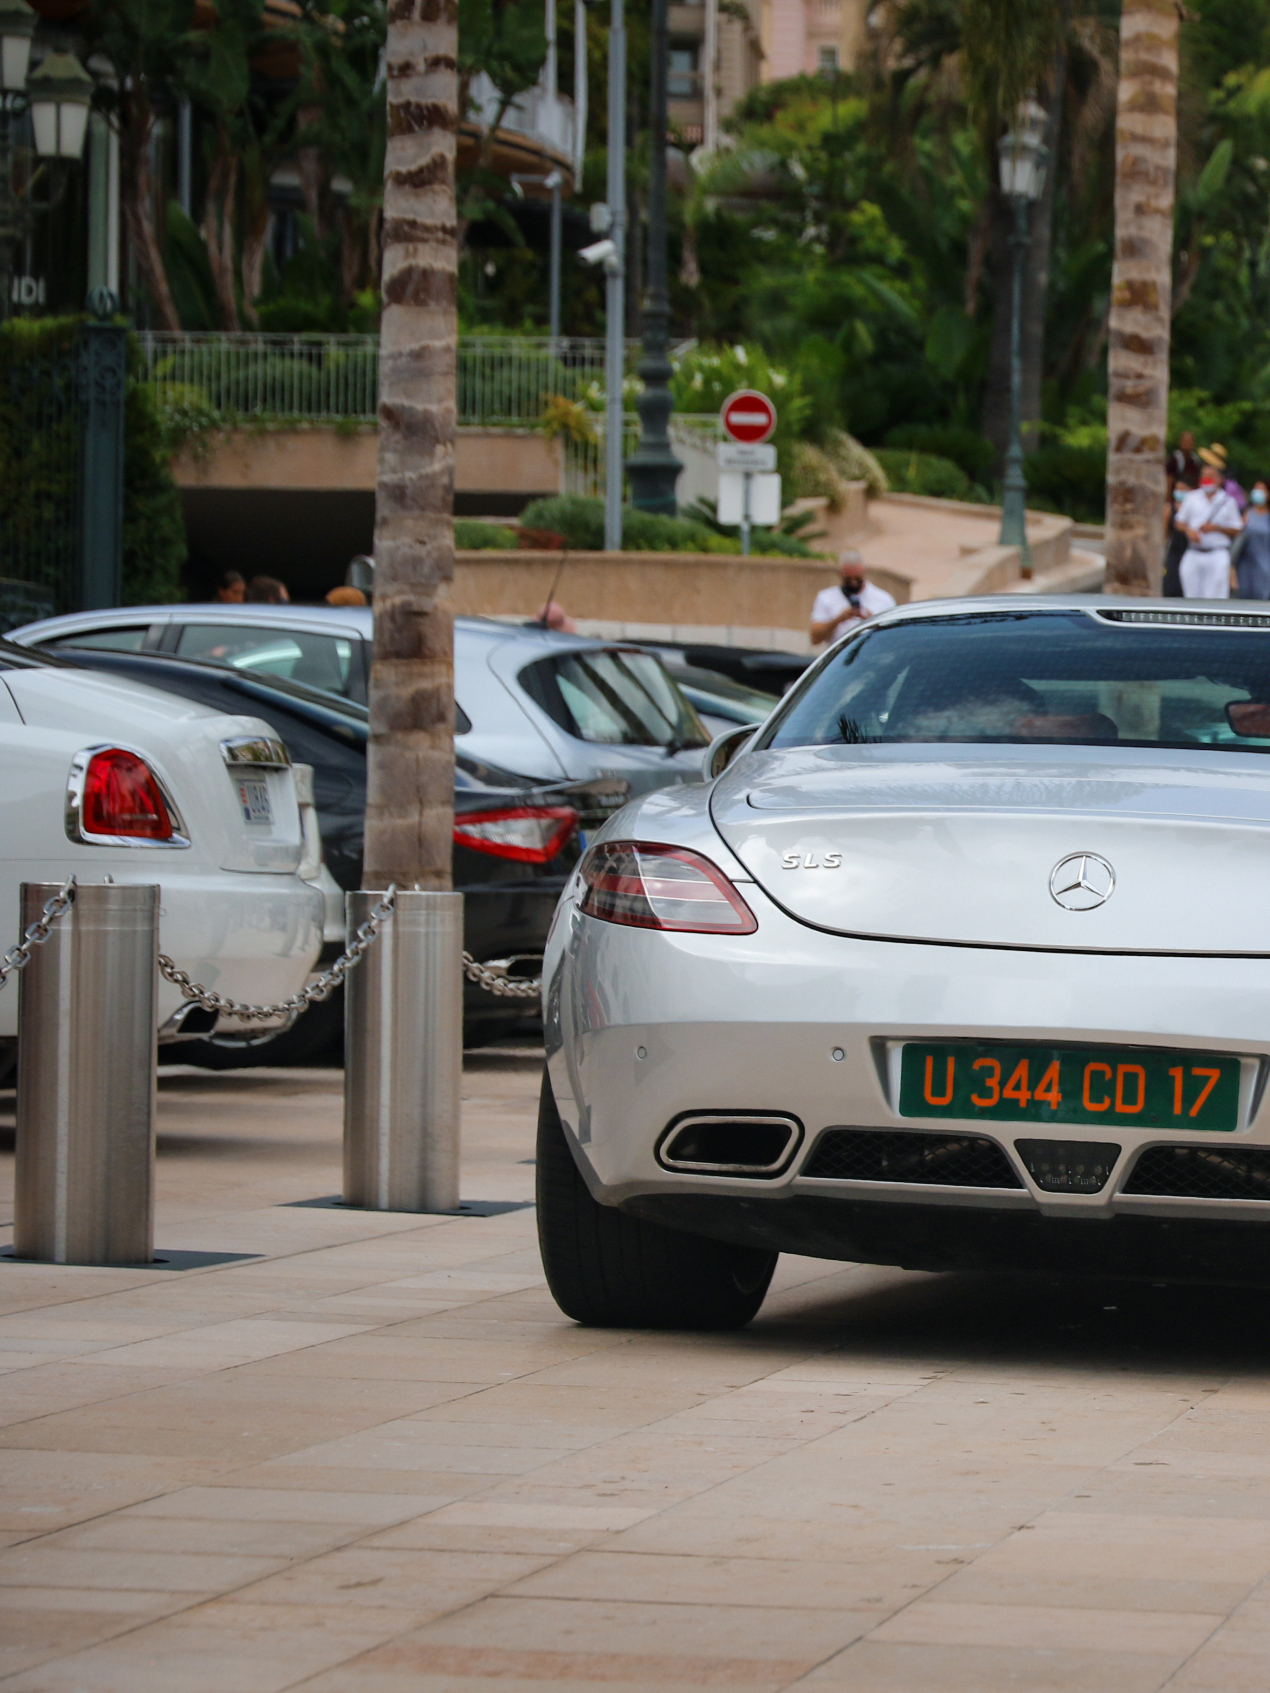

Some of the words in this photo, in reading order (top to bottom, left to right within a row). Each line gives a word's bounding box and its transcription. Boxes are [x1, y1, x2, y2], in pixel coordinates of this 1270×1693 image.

[781, 852, 843, 869] SLS
[924, 1056, 955, 1106] U
[971, 1058, 1062, 1110] 344
[1082, 1062, 1146, 1114] CD
[1169, 1066, 1221, 1117] 17
